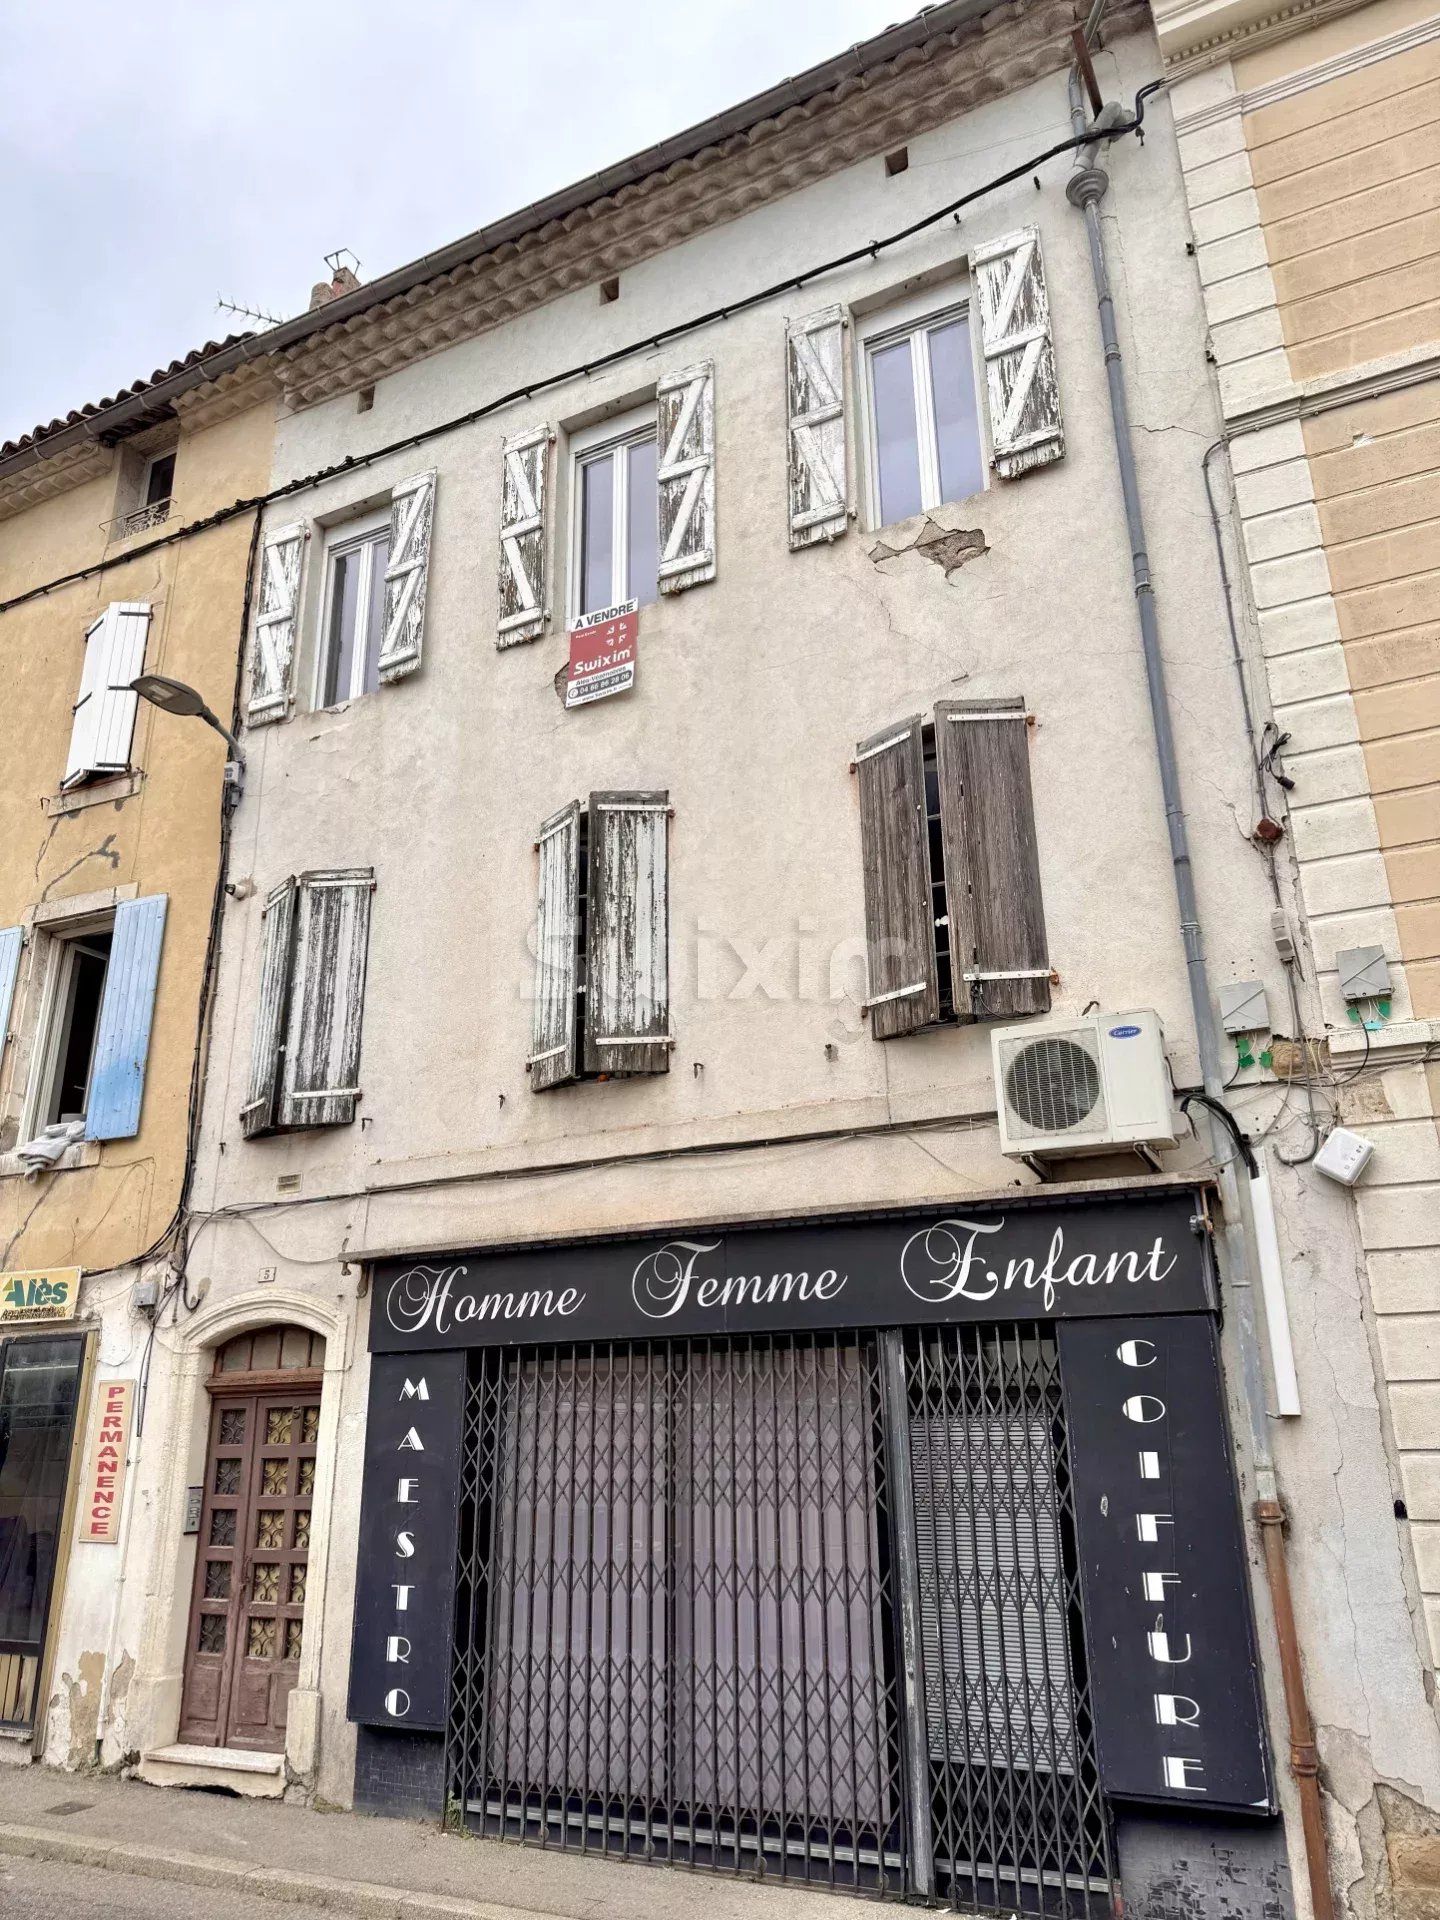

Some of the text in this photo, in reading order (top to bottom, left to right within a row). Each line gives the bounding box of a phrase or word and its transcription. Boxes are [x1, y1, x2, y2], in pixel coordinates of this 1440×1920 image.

[575, 602, 634, 630] A VENDRE
[573, 649, 631, 676] Swixim
[2, 1276, 69, 1308] Alès
[264, 1270, 270, 1280] 5
[386, 1216, 1178, 1334] Homme Femme Enfant
[91, 1386, 126, 1535] PERMANENCE
[384, 1377, 430, 1717] MAESTRO
[1116, 1339, 1207, 1791] COIFFURE
